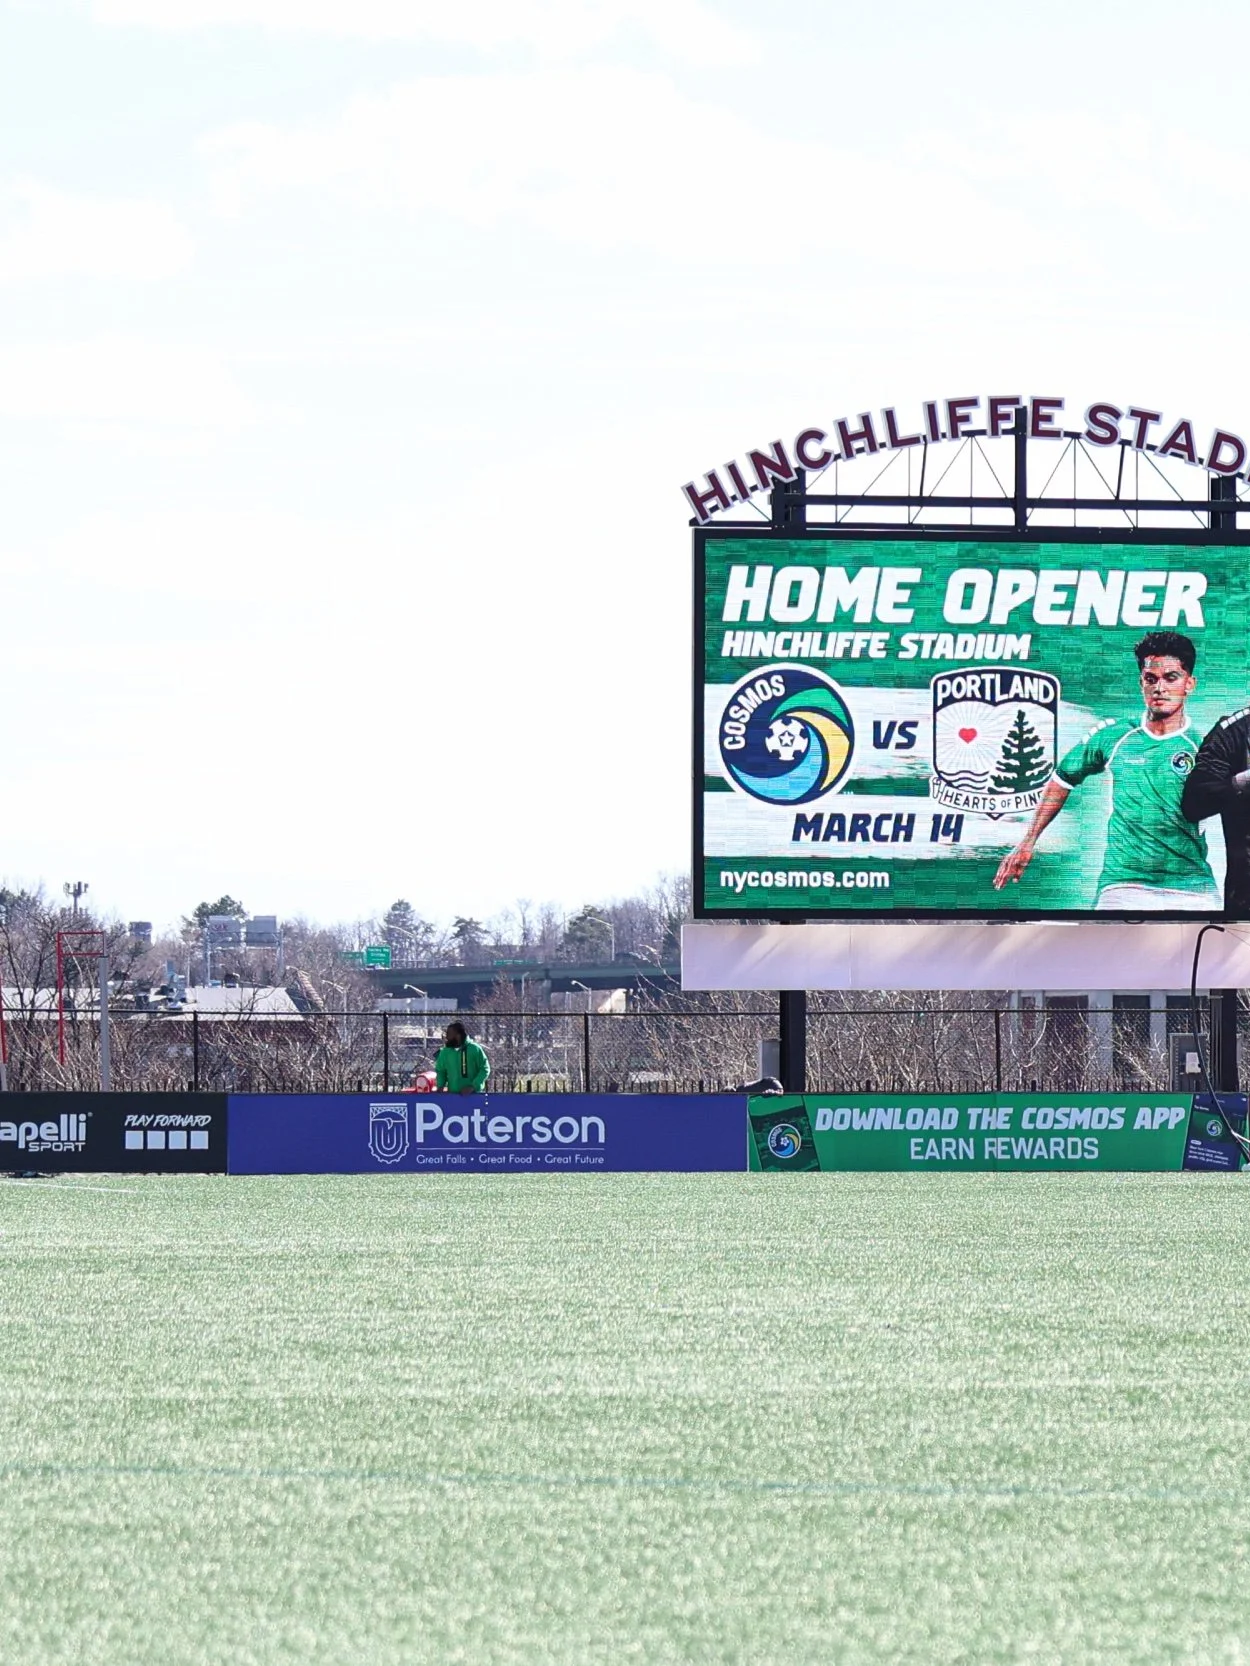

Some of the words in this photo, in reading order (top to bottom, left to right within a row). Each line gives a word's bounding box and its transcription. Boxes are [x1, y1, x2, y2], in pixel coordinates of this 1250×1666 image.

[681, 395, 1064, 525] HINCHLIFFE
[722, 565, 922, 623] HOME
[943, 568, 1208, 628] OPENER
[721, 630, 890, 658] HINCHLIFFE
[898, 632, 1031, 660] STADIUM
[937, 673, 1055, 707] PORTLAND
[723, 674, 786, 750] COSMOS
[872, 720, 919, 750] VS
[944, 789, 997, 811] HEARTS
[792, 812, 916, 843] MARCH
[929, 813, 964, 843] 14
[720, 870, 890, 893] nycosmos.com
[124, 1114, 155, 1127] PLAY
[153, 1114, 212, 1127] FORWARD
[415, 1102, 606, 1144] Paterson
[815, 1107, 959, 1131] DOWNLOAD
[967, 1107, 1014, 1130] THE
[1021, 1107, 1127, 1130] COSMOS
[1133, 1107, 1186, 1130] APP
[28, 1141, 86, 1152] SPORT
[416, 1154, 444, 1164] Great
[446, 1154, 467, 1164] Falls
[478, 1153, 506, 1164] Great
[508, 1153, 533, 1164] Food
[544, 1153, 572, 1164] Great
[574, 1153, 605, 1164] Future
[910, 1137, 975, 1160] EARN
[984, 1137, 1099, 1160] REWARDS
